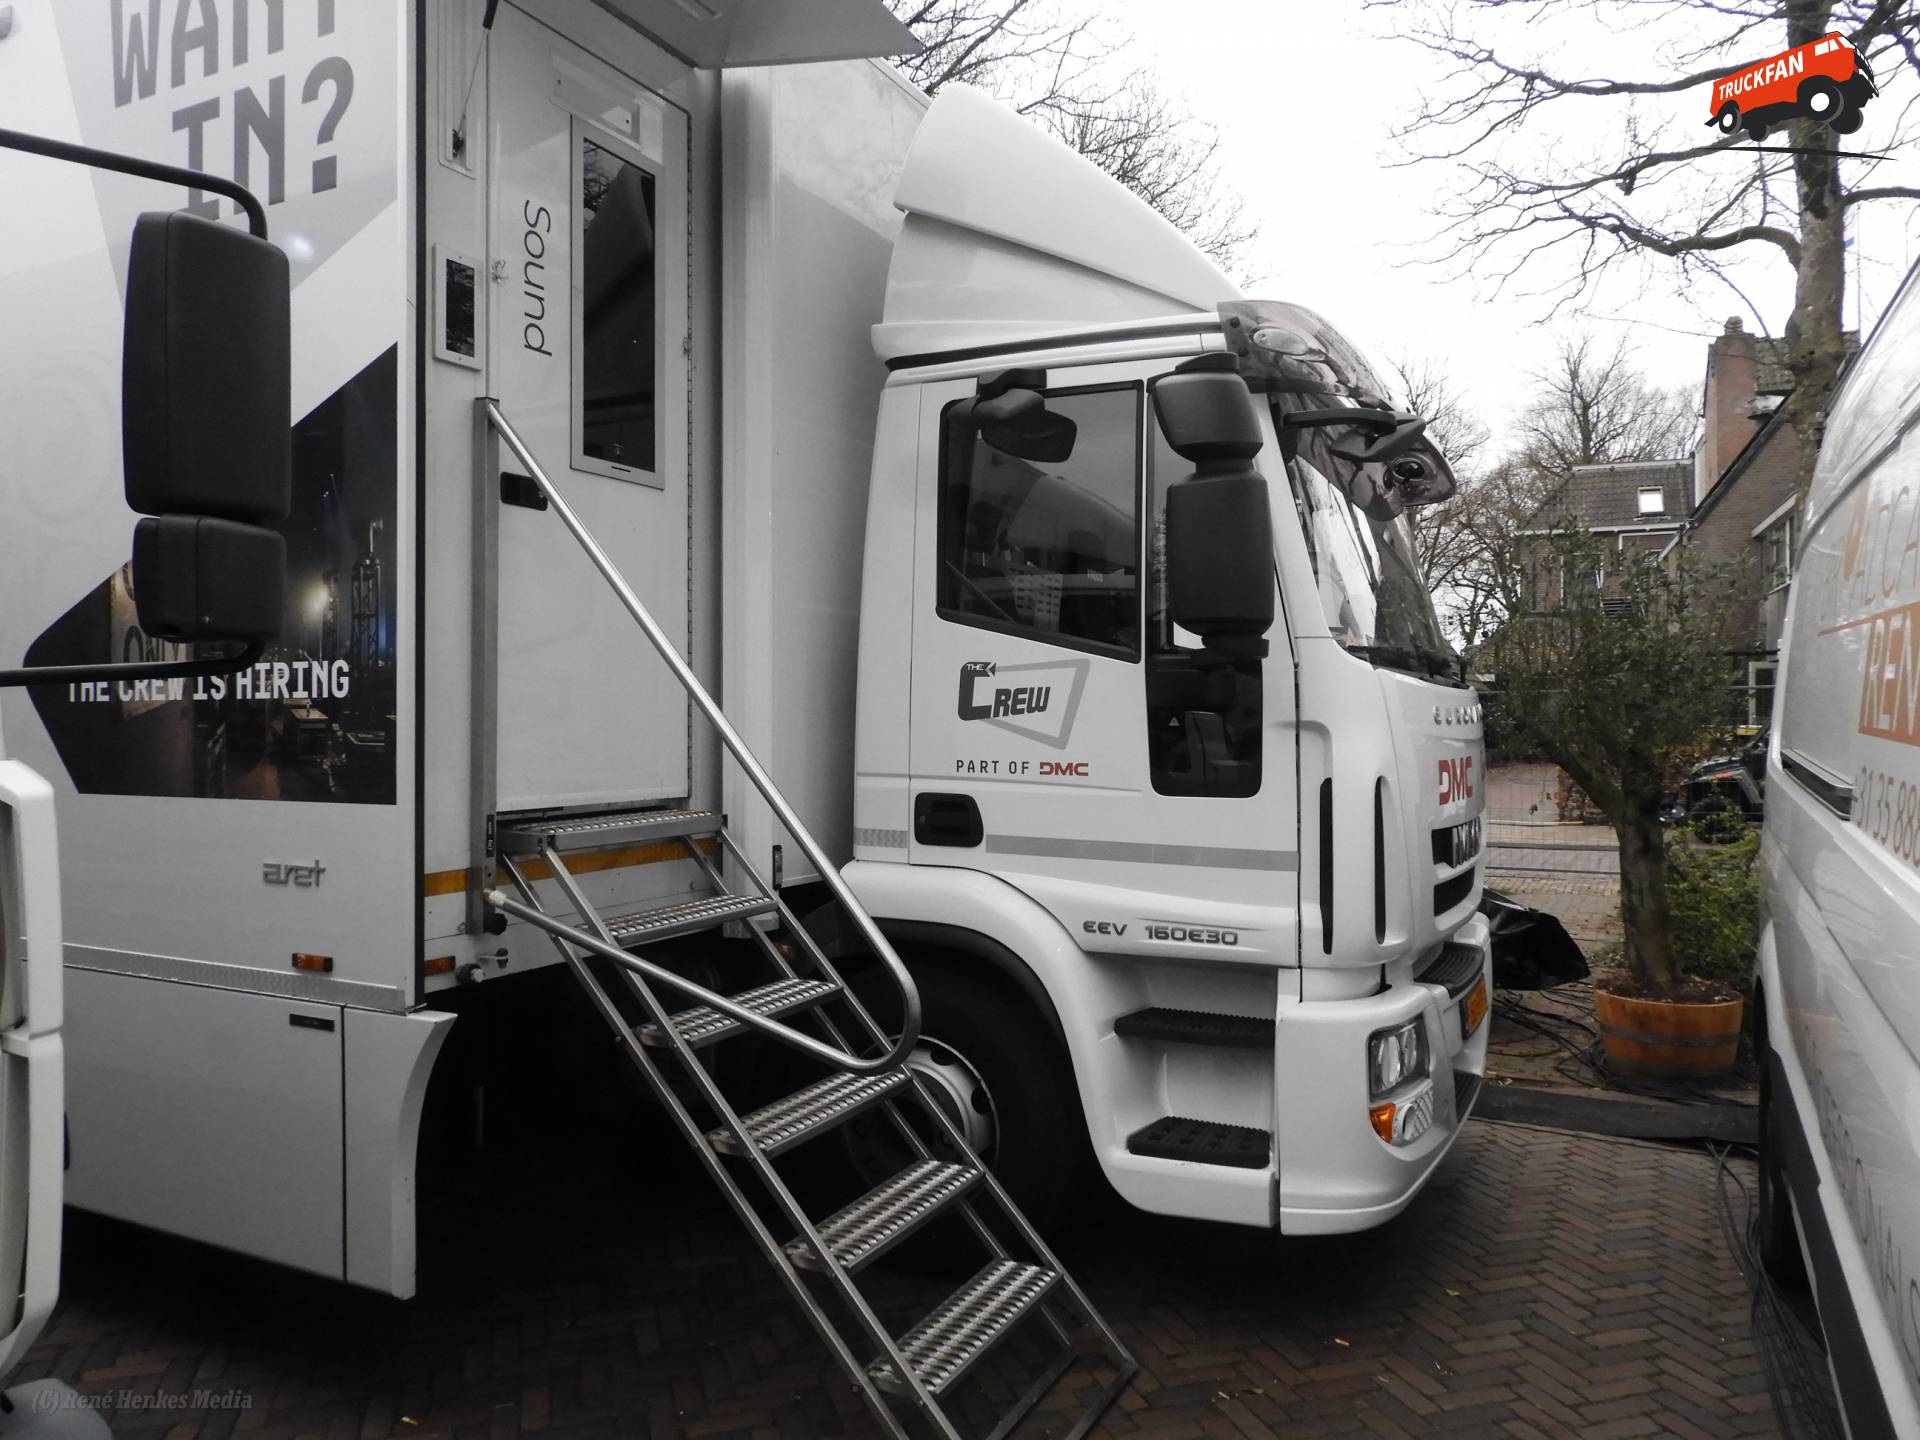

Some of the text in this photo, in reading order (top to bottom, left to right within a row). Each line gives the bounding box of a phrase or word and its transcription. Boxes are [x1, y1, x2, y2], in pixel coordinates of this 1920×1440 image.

[172, 56, 354, 222] IN?
[524, 200, 552, 357] Sound
[193, 674, 226, 700] IS
[236, 659, 350, 699] HIRING
[966, 663, 985, 671] THE
[958, 662, 1051, 721] CREW
[956, 760, 1089, 776] PART OF DMC
[1439, 756, 1473, 806] DMC
[1083, 920, 1239, 946] EEV 160E30
